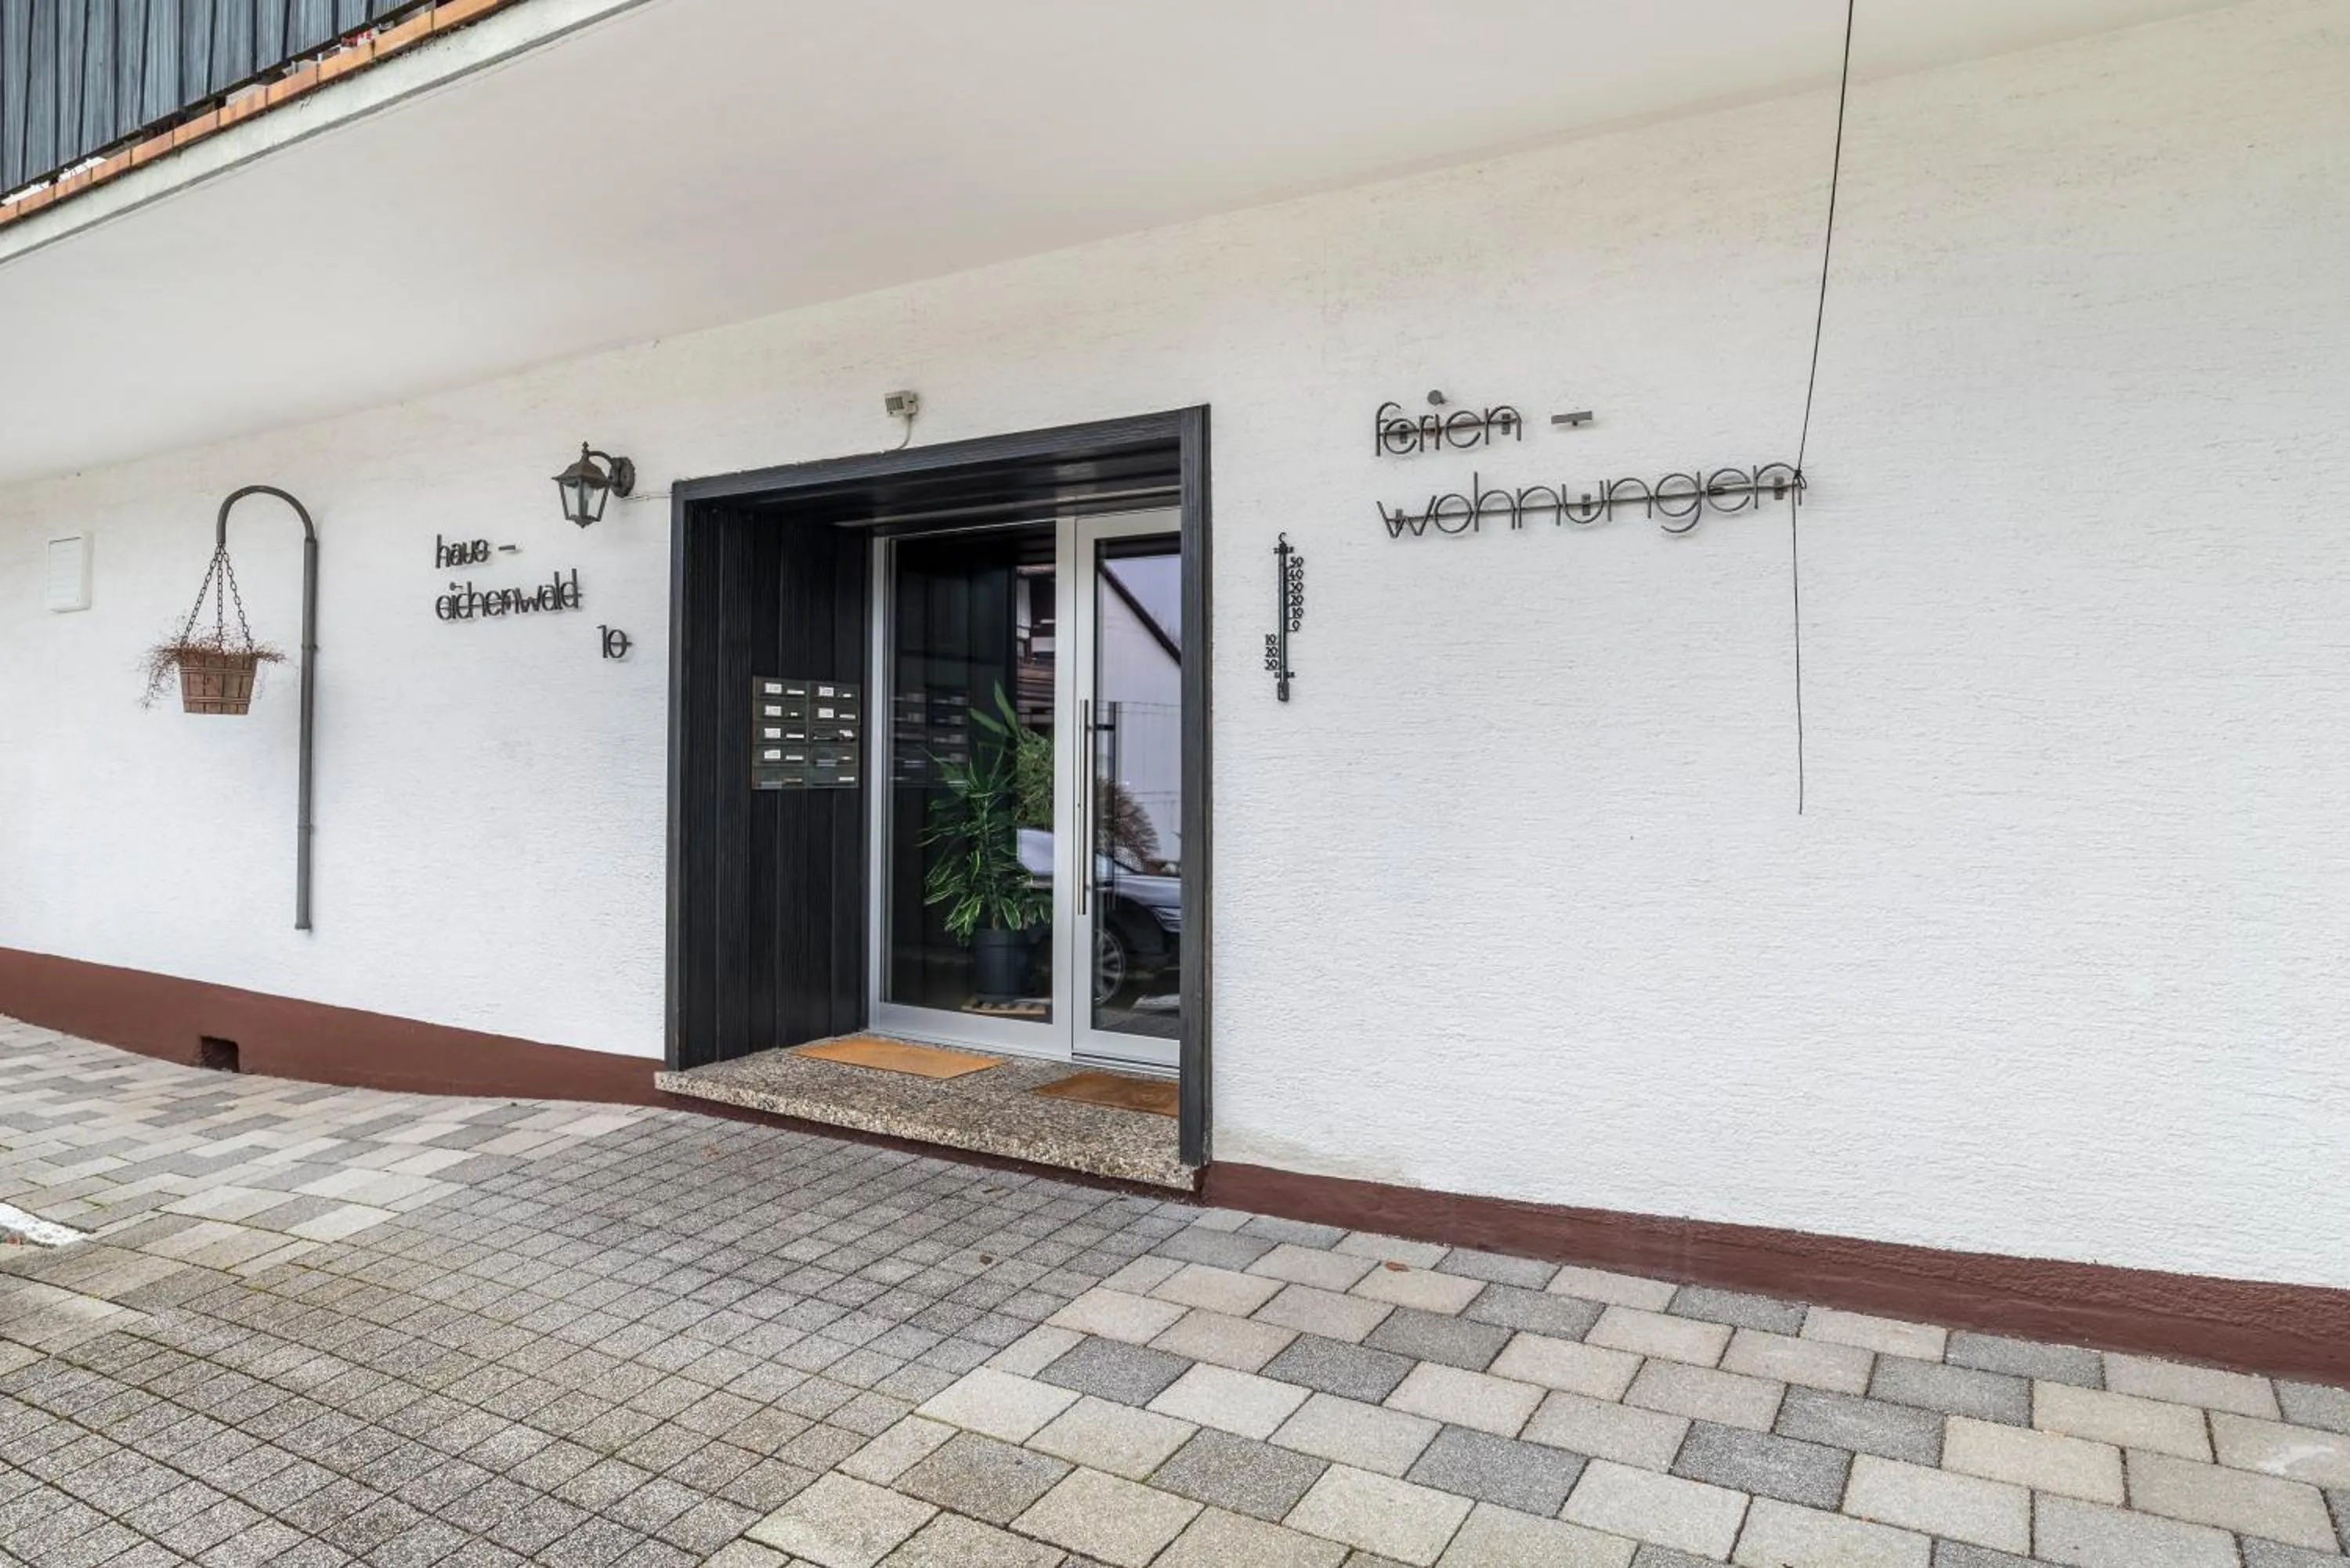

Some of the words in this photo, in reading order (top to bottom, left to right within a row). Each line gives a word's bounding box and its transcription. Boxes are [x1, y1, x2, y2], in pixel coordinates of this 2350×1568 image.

[1376, 389, 1521, 457] ferien
[1376, 462, 1803, 538] wohnungen
[436, 533, 490, 569] haus
[436, 568, 580, 620] eichenwald
[595, 624, 631, 659] 10
